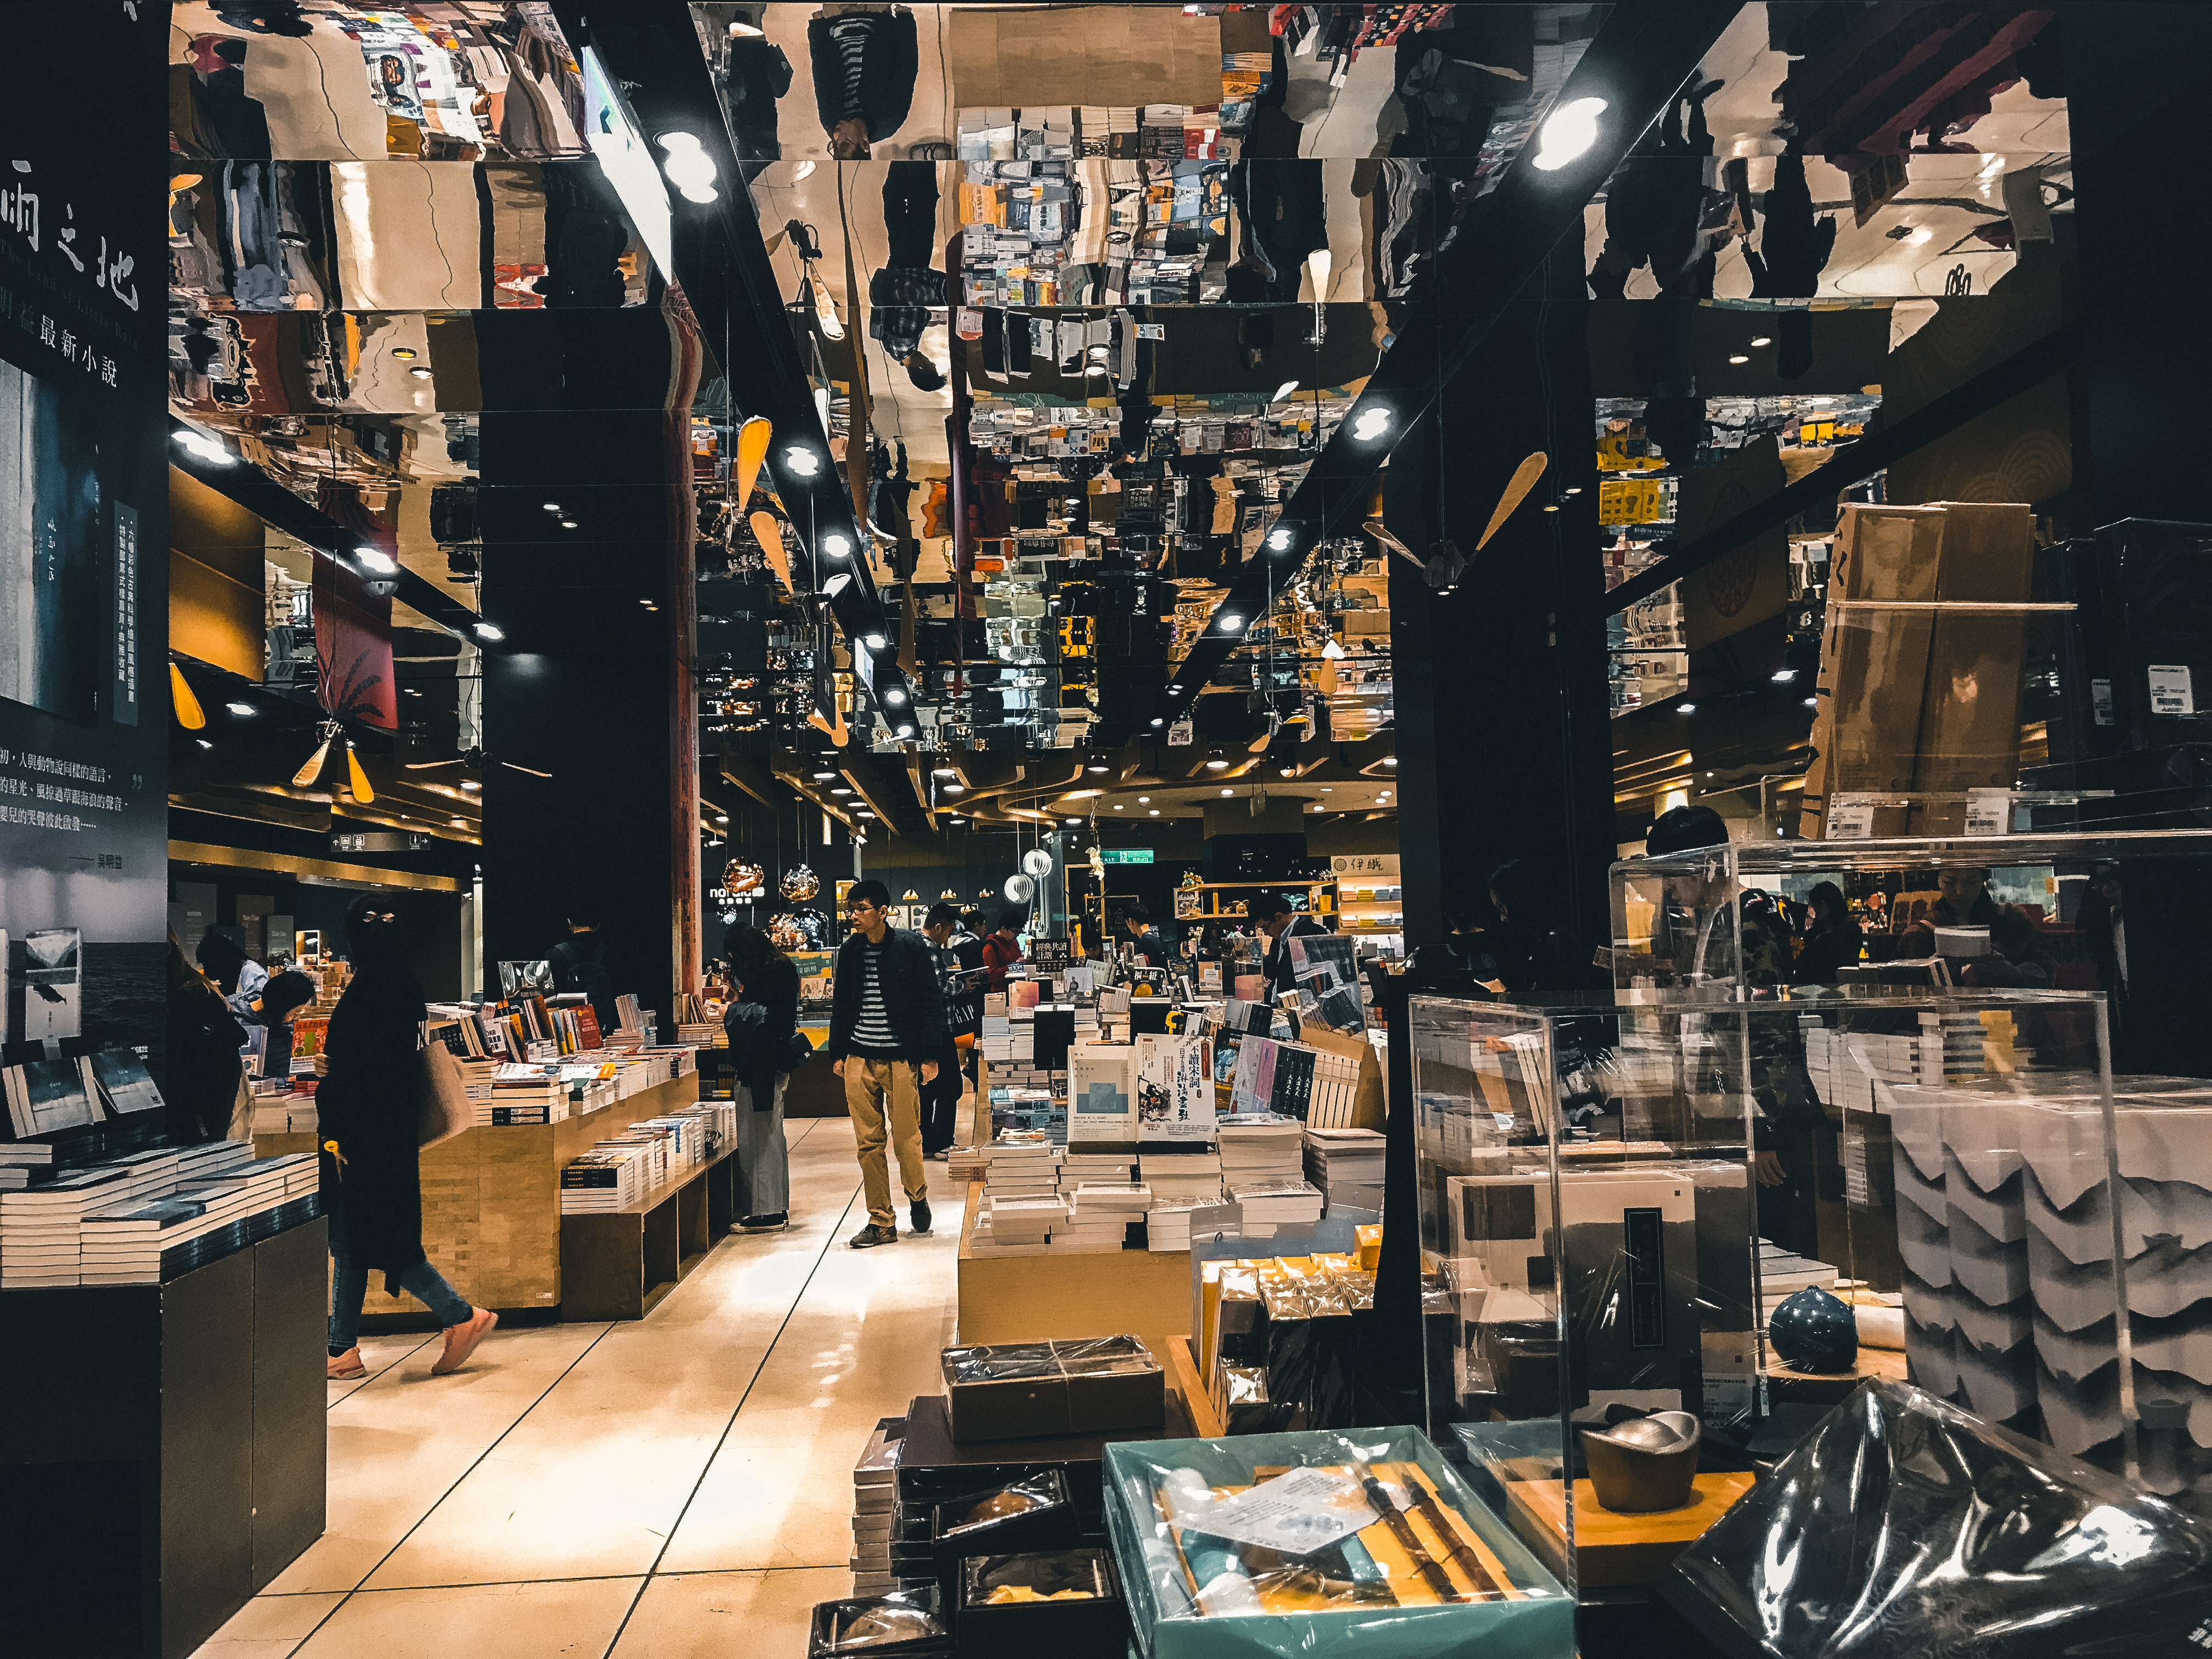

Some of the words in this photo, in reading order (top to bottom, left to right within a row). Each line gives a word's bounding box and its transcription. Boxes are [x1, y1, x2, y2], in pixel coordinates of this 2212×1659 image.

[27, 259, 57, 293] Land
[61, 289, 74, 304] of
[77, 295, 110, 330] Little
[115, 322, 138, 350] Rain
[955, 1004, 974, 1024] GAP
[1188, 1045, 1200, 1088] 不讀宋詞
